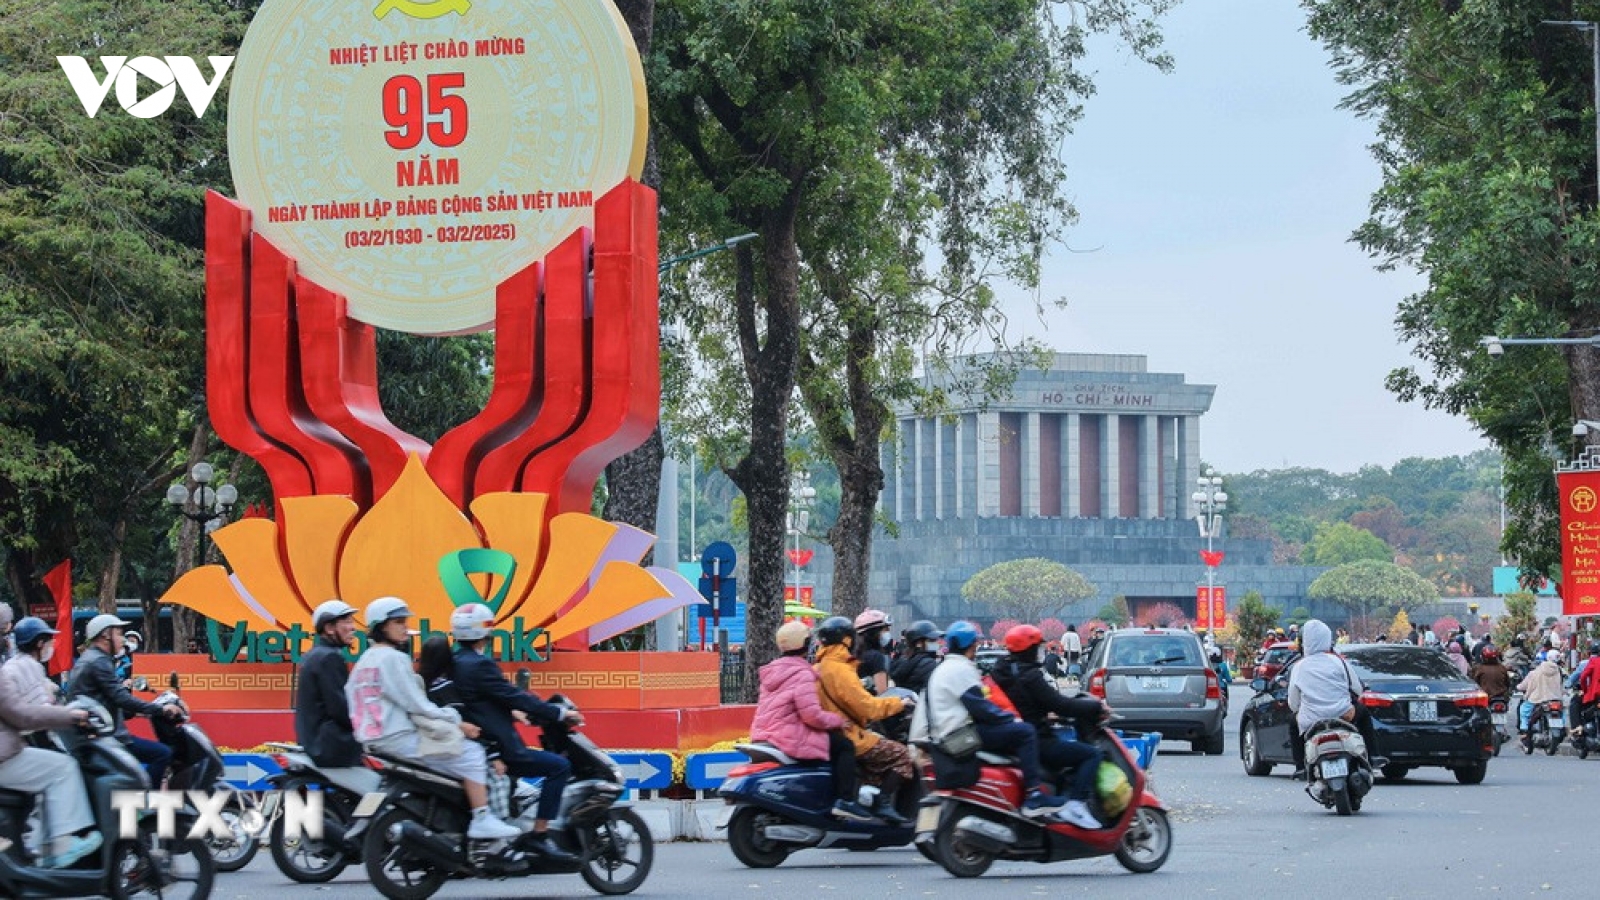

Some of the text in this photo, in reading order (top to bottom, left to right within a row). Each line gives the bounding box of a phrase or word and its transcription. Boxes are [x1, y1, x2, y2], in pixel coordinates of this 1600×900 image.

[329, 35, 526, 67] NHIỆT LIỆT CHÀO MỪNG
[382, 72, 468, 150] 95
[396, 154, 460, 188] NĂM
[268, 189, 593, 222] NGÀY THÀNH LẬP ĐẢNG CỘNG SẢN VIỆT NAM
[345, 228, 423, 249] (03/2/1930
[437, 223, 516, 243] 03/2/2025)
